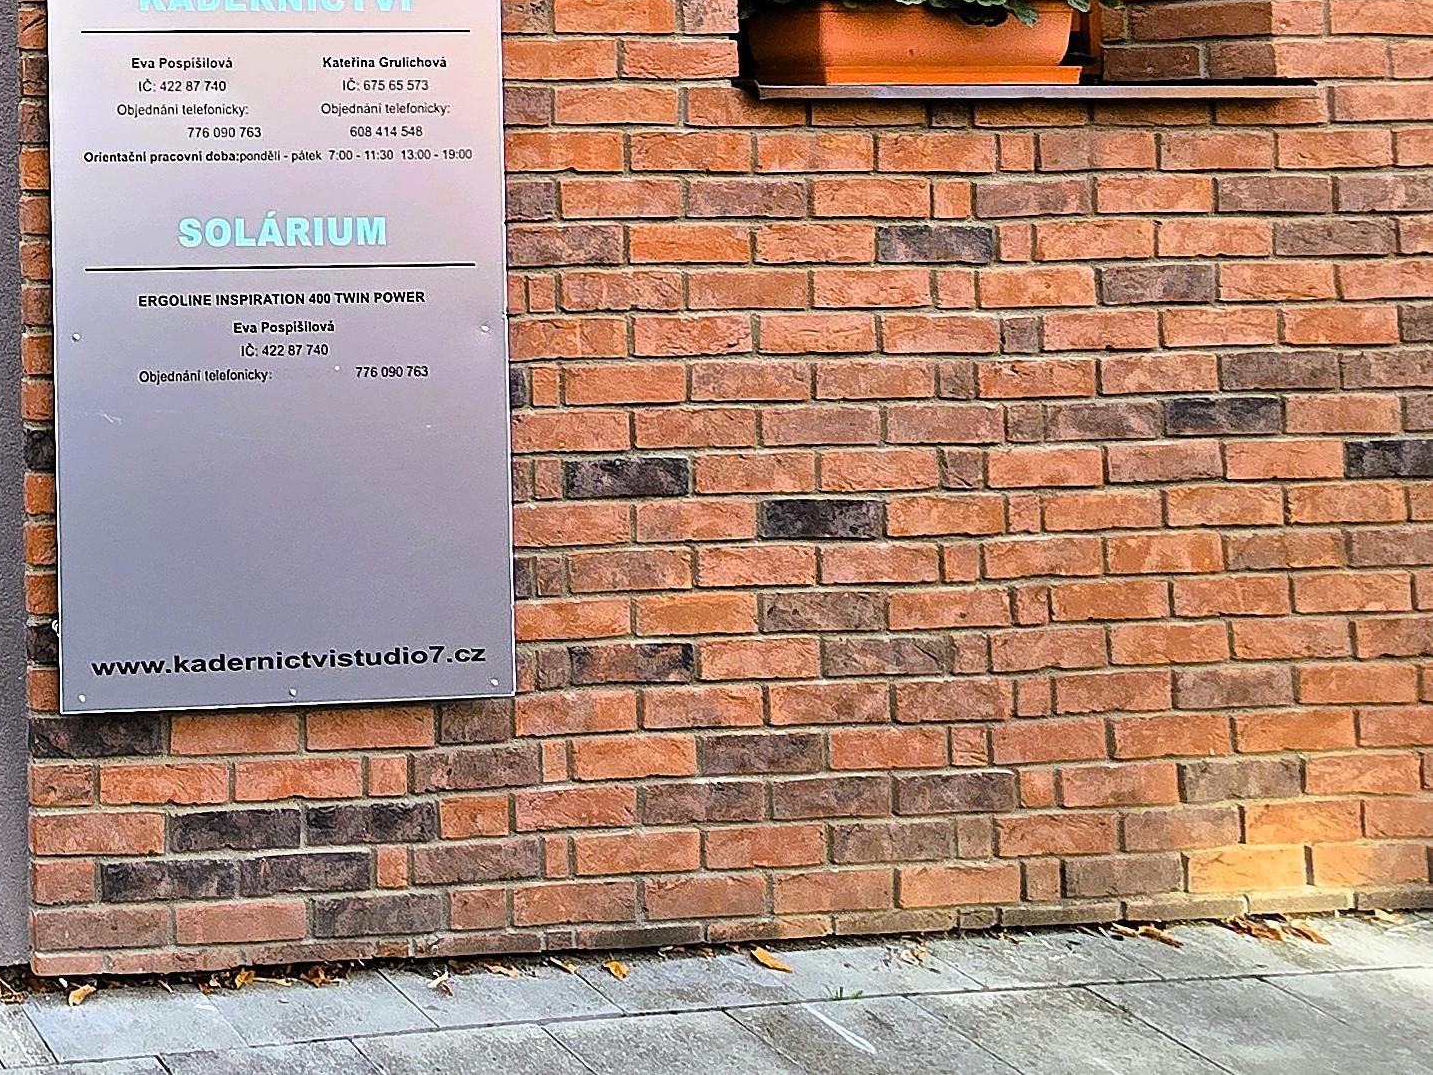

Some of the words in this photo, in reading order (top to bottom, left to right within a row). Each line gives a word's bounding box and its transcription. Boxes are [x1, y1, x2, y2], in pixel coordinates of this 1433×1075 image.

[131, 57, 156, 69] Eva
[158, 56, 233, 72] Pospíšilová
[322, 56, 376, 68] Kateřina
[378, 55, 447, 68] Grulichová
[138, 77, 157, 93] IČ:
[159, 80, 183, 93] 422
[185, 80, 201, 92] 87
[203, 79, 227, 92] 740
[342, 76, 361, 92] IČ:
[363, 79, 386, 92] 675
[388, 79, 404, 92] 65
[406, 79, 430, 91] 573
[116, 103, 179, 119] Objednání
[181, 102, 250, 118] telefonicky:
[320, 102, 383, 118] Objednání
[384, 101, 451, 117] telefonicky:
[186, 126, 210, 139] 776
[212, 126, 236, 139] 090
[238, 126, 262, 138] 763
[349, 125, 373, 138] 608
[375, 125, 398, 138] 414
[400, 125, 424, 138] 548
[83, 150, 147, 163] Orientační
[149, 150, 203, 165] pracovní
[291, 149, 323, 164] pátek
[328, 149, 354, 161] 7:00
[364, 149, 394, 161] 11:30
[400, 148, 432, 161] 13:00
[442, 148, 473, 160] 19:00
[177, 210, 388, 248] SOLÁRIUM
[138, 294, 212, 308] ERGOLINE
[215, 293, 305, 306] INSPIRATION
[308, 292, 331, 305] 400
[334, 291, 370, 305] TWIN
[373, 290, 426, 304] POWER
[233, 321, 258, 334] Eva
[261, 319, 335, 336] Pospíšilová
[241, 342, 259, 358] IČ:
[261, 344, 285, 357] 422
[287, 344, 303, 357] 87
[305, 343, 329, 356] 740
[138, 369, 202, 386] Objednání
[204, 368, 273, 383] telefonicky:
[355, 366, 379, 379] 776
[380, 365, 404, 378] 090
[406, 365, 429, 378] 763
[90, 645, 487, 676] www.kadernictvistudio7.cz
